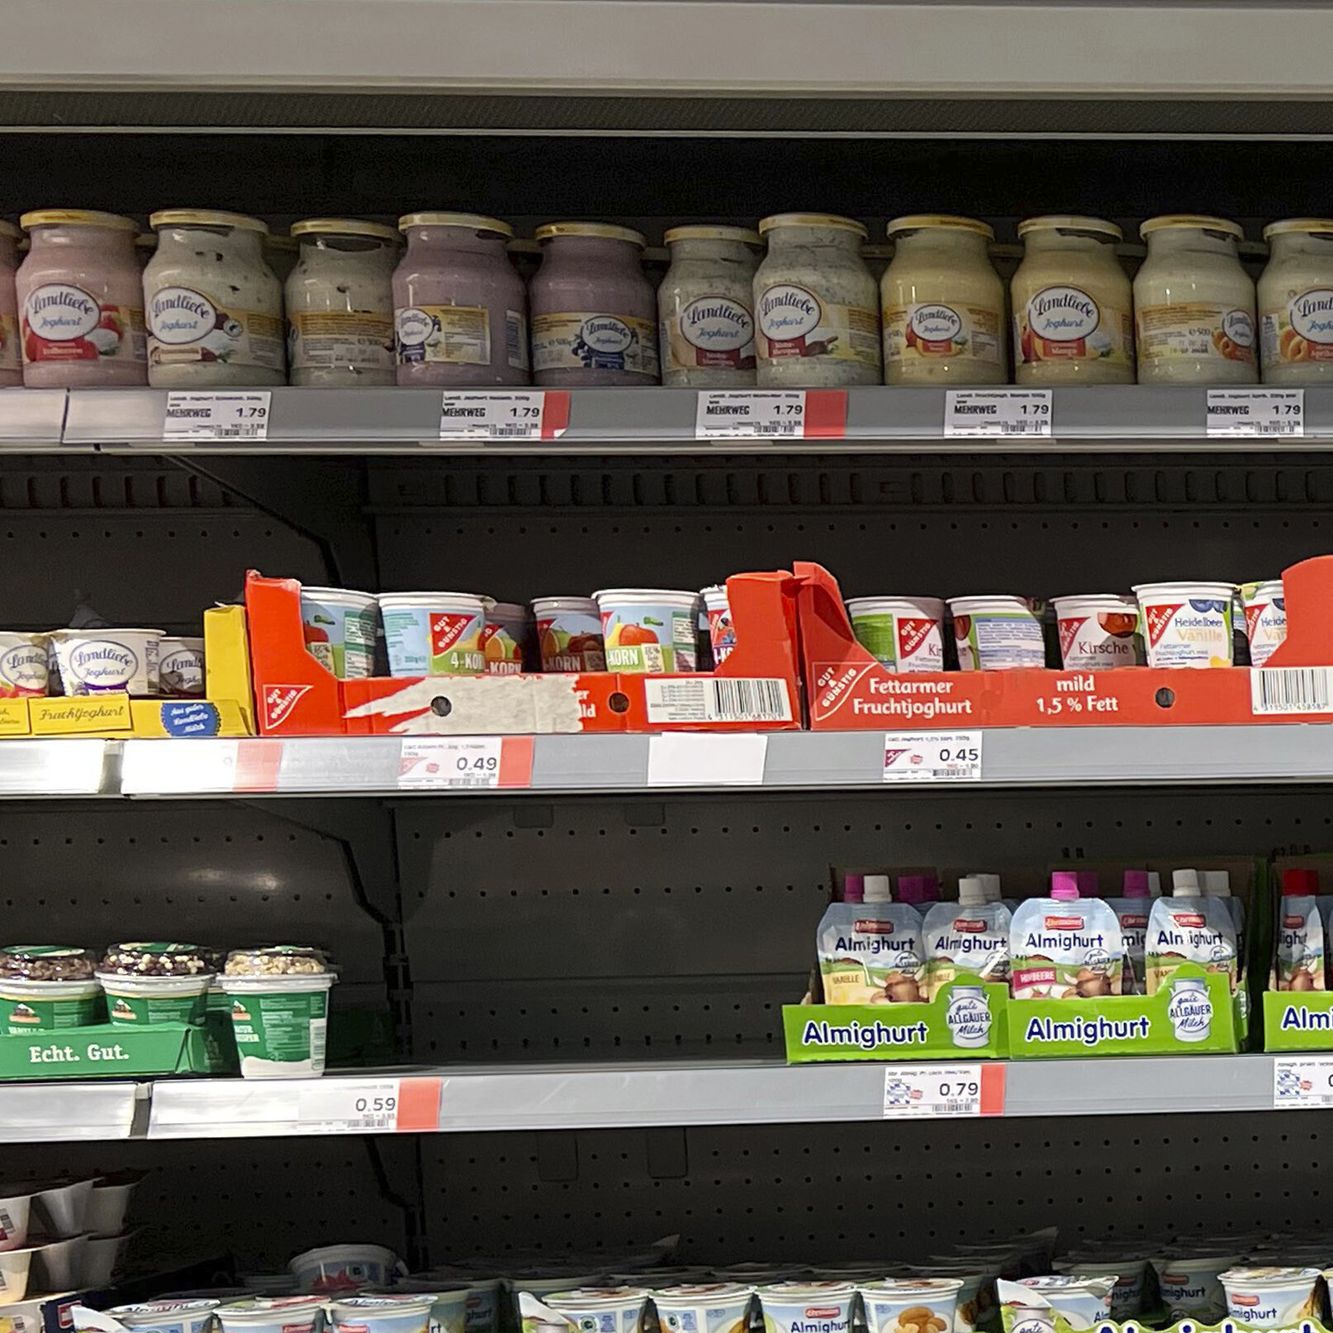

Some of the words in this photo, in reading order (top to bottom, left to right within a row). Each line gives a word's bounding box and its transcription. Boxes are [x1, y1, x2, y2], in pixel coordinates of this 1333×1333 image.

[27, 288, 96, 314] Landliebe
[687, 303, 751, 329] Landliebe
[167, 408, 211, 418] MEHRWEG
[236, 407, 267, 418] 1.79
[707, 404, 750, 416] MEHRWEG
[773, 403, 804, 416] 1.79
[954, 404, 997, 415] MEHRWEG
[1020, 403, 1050, 415] 1.79
[1208, 405, 1249, 415] MEHRWEG
[1272, 404, 1301, 415] 1.79
[1078, 642, 1130, 656] Kirsche
[75, 651, 137, 670] Landliebe
[869, 677, 954, 695] Fettarmer
[1056, 675, 1095, 692] mild
[853, 698, 972, 718] Fruchtjoghurt
[1036, 697, 1063, 715] 1,5
[1066, 697, 1083, 713] %
[1087, 695, 1119, 712] Fett
[40, 705, 124, 722] Fruchtjoghurt
[939, 747, 979, 763] 0.45
[456, 757, 498, 771] 0.49
[1025, 930, 1103, 951] Almighurt
[802, 1020, 929, 1049] Almighurt
[29, 1045, 80, 1063] Echt.
[88, 1044, 130, 1062] Gut.
[939, 1080, 979, 1096] 0.79
[354, 1096, 396, 1113] 0.59
